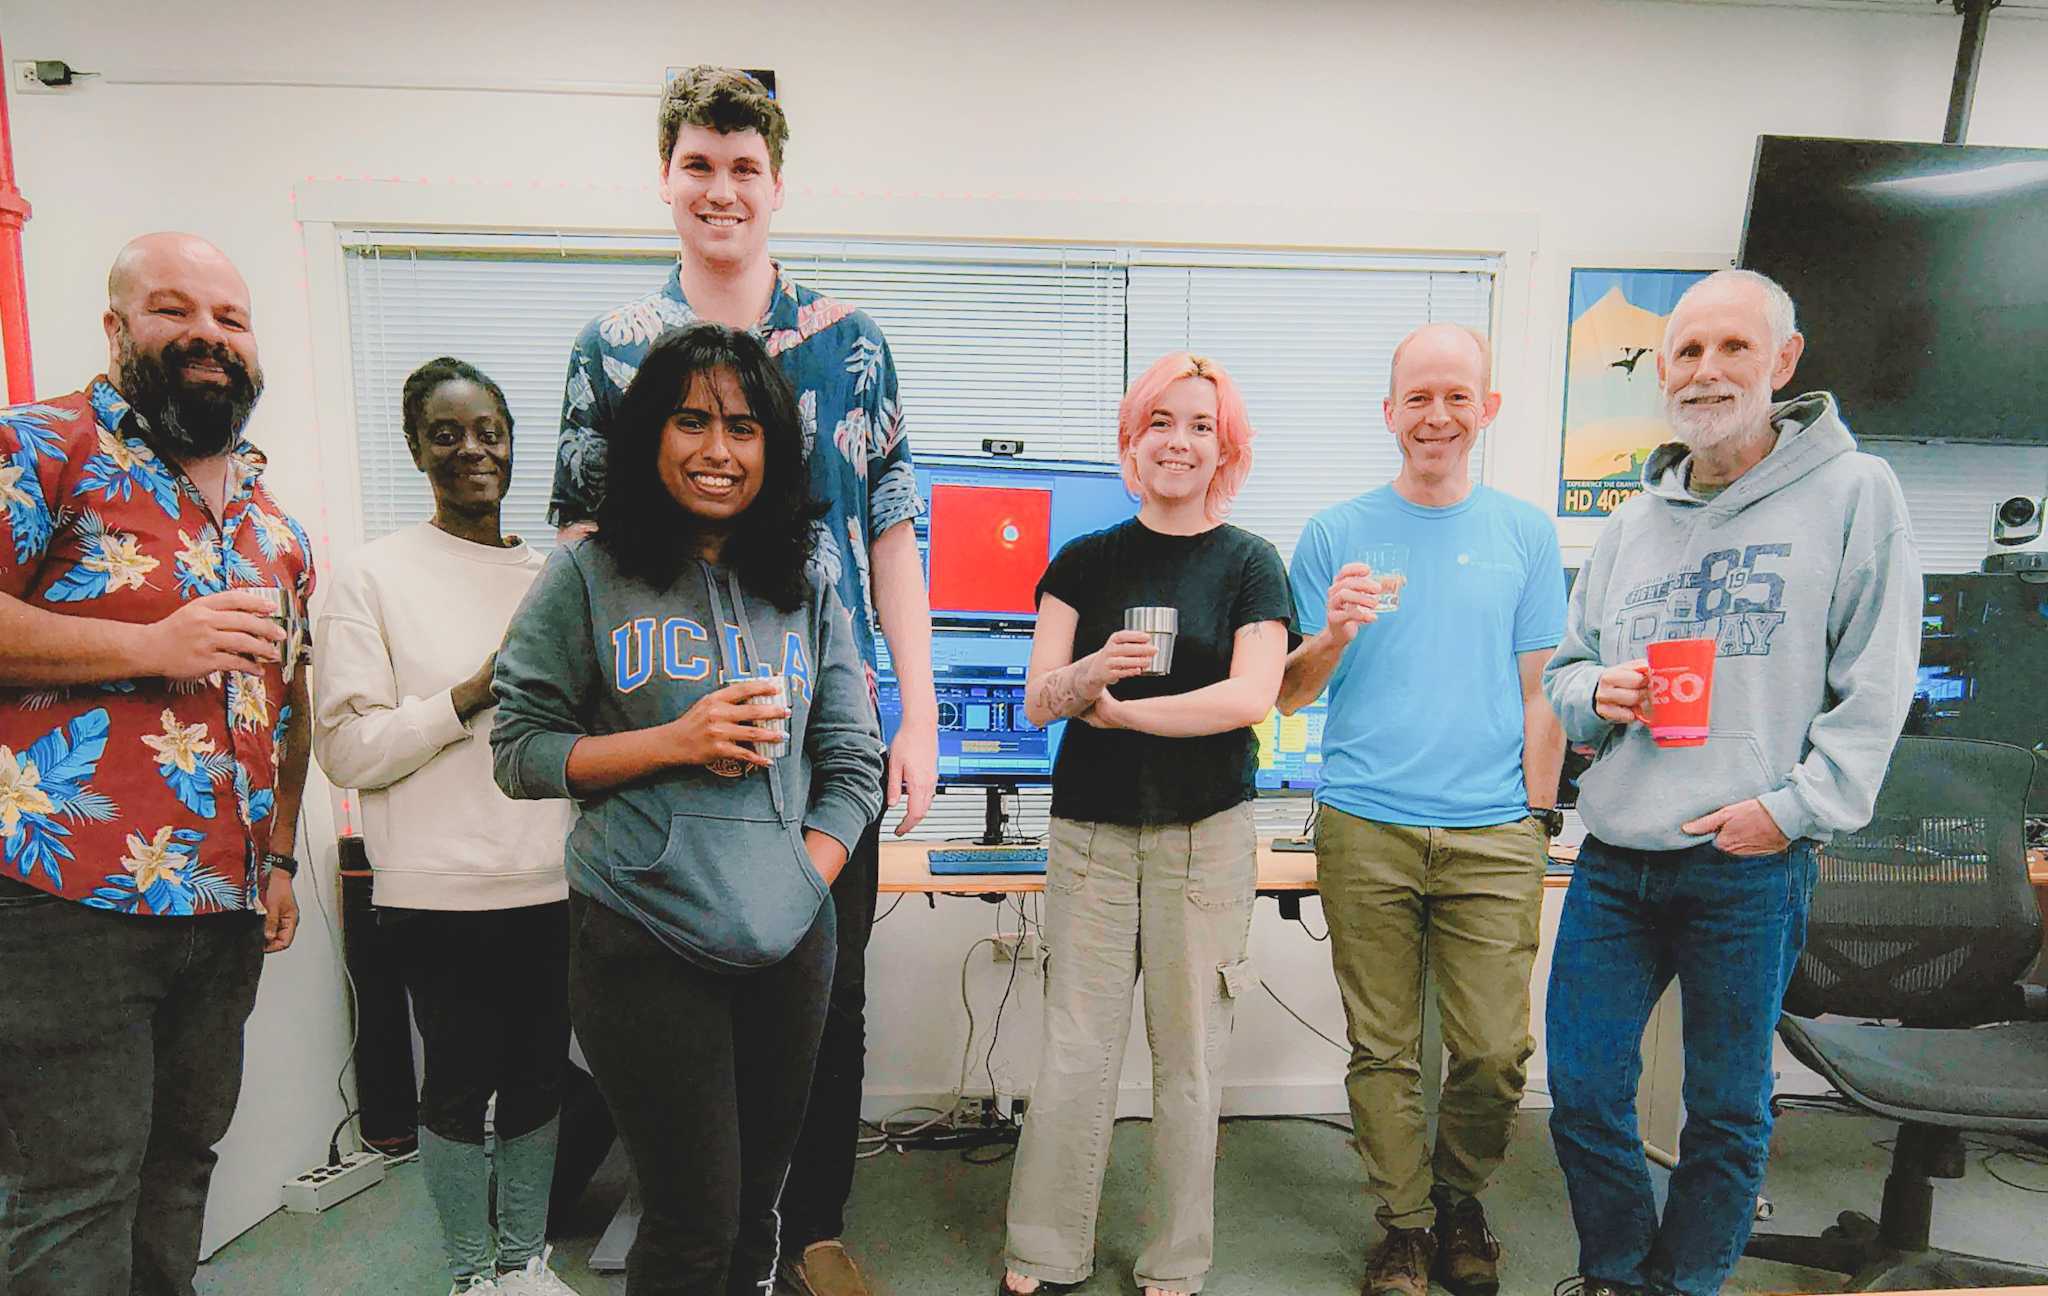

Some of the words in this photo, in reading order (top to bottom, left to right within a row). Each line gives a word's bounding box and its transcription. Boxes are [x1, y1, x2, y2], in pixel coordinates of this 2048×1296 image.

[1565, 489, 1593, 512] HD
[1697, 543, 1792, 620] 85
[1728, 571, 1747, 590] 19
[613, 617, 814, 705] UCLA
